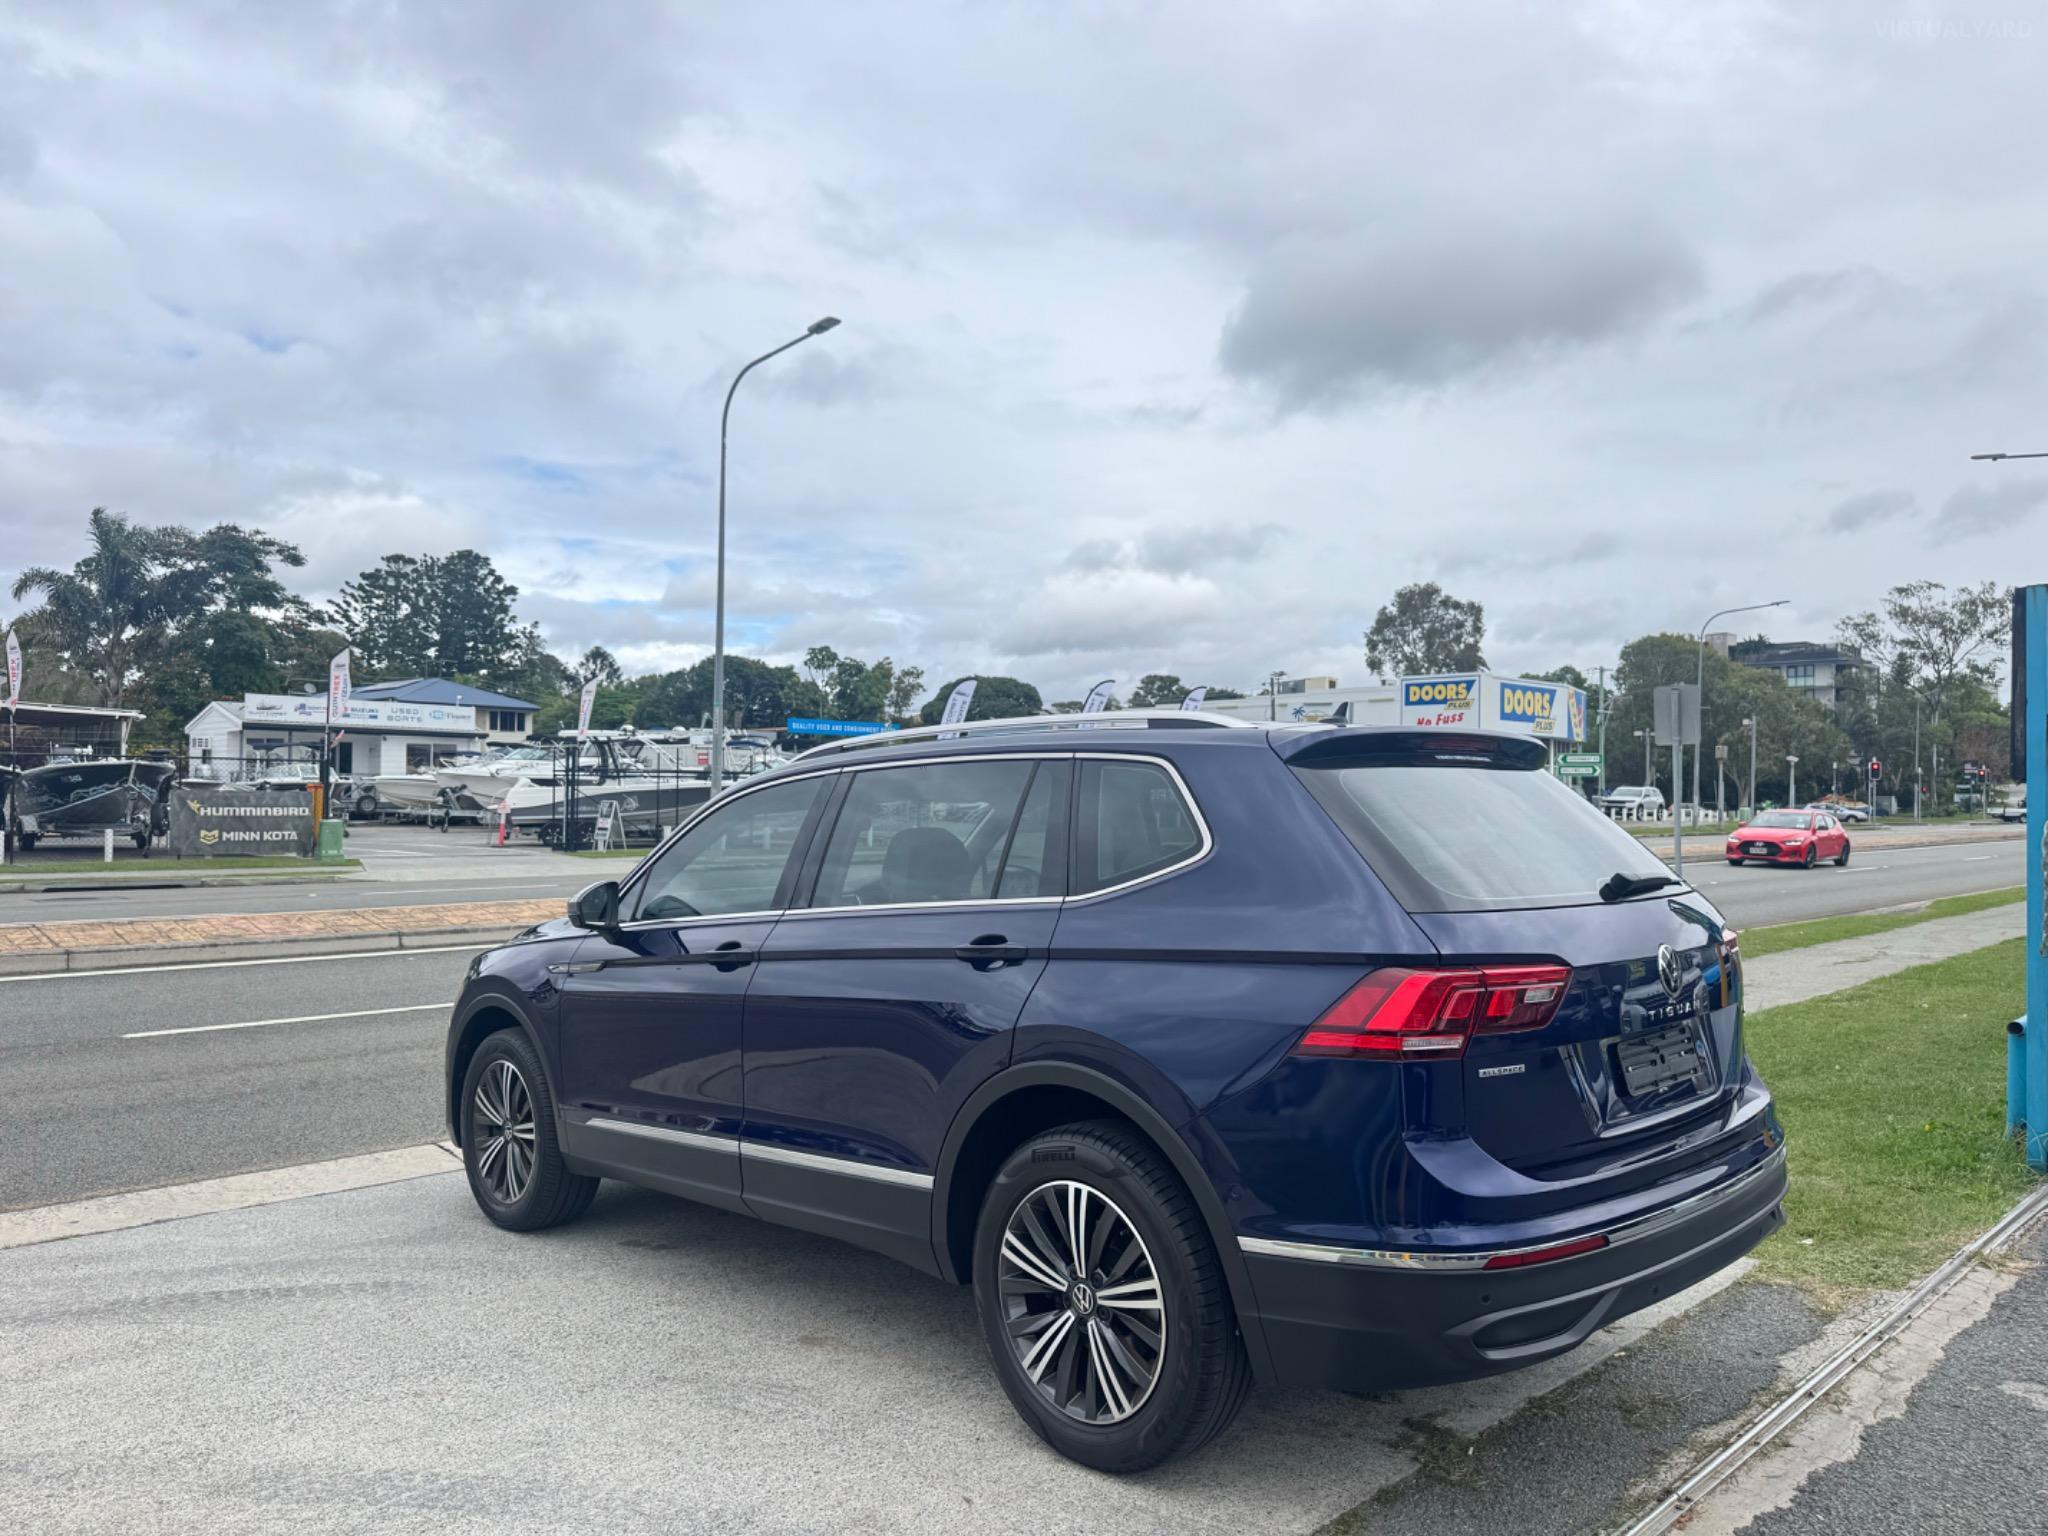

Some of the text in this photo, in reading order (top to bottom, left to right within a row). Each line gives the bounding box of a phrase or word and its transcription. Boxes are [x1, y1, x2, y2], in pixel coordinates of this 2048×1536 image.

[1409, 683, 1468, 702] DOORS
[1447, 701, 1471, 709] PLUS
[1503, 688, 1551, 717] DOORS
[391, 707, 420, 715] USED
[1535, 720, 1553, 731] PLUS
[222, 831, 298, 841] MINN KOTA
[1031, 1145, 1075, 1163] PIRELLI
